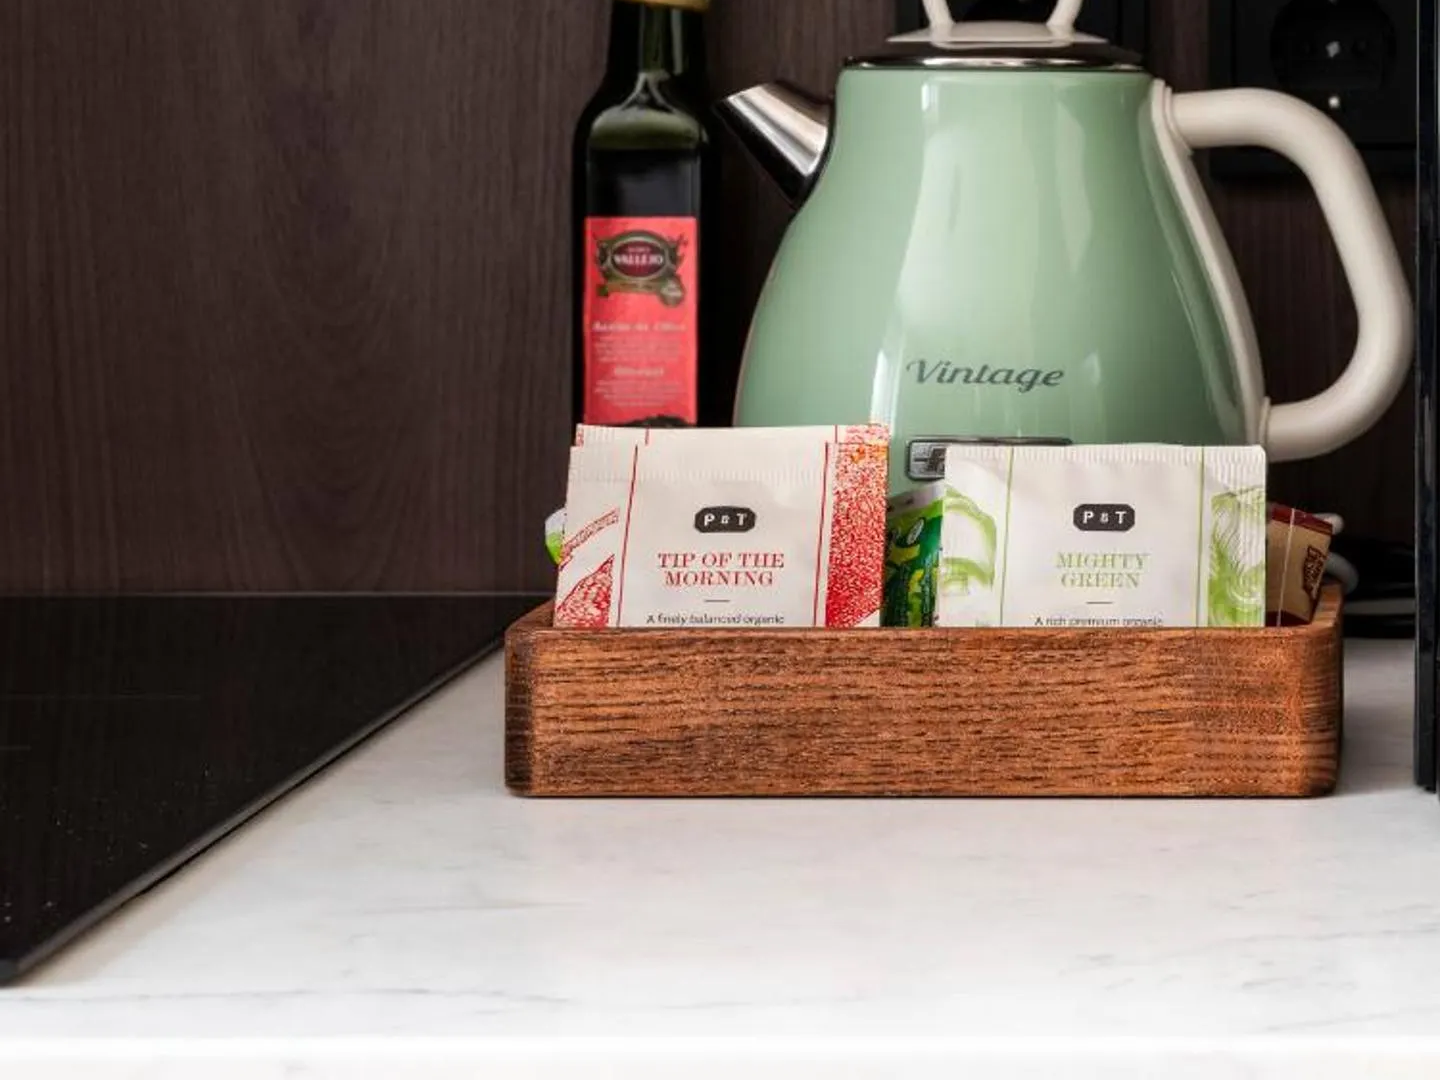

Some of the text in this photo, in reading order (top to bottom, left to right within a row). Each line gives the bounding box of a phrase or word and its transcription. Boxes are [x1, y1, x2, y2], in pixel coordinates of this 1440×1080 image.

[906, 358, 1065, 393] Vintage
[658, 553, 784, 568] TIP OF THE
[1056, 553, 1151, 569] MIGHTY
[665, 570, 773, 587] MORNING
[1061, 572, 1141, 588] GREEN
[646, 615, 655, 624] A
